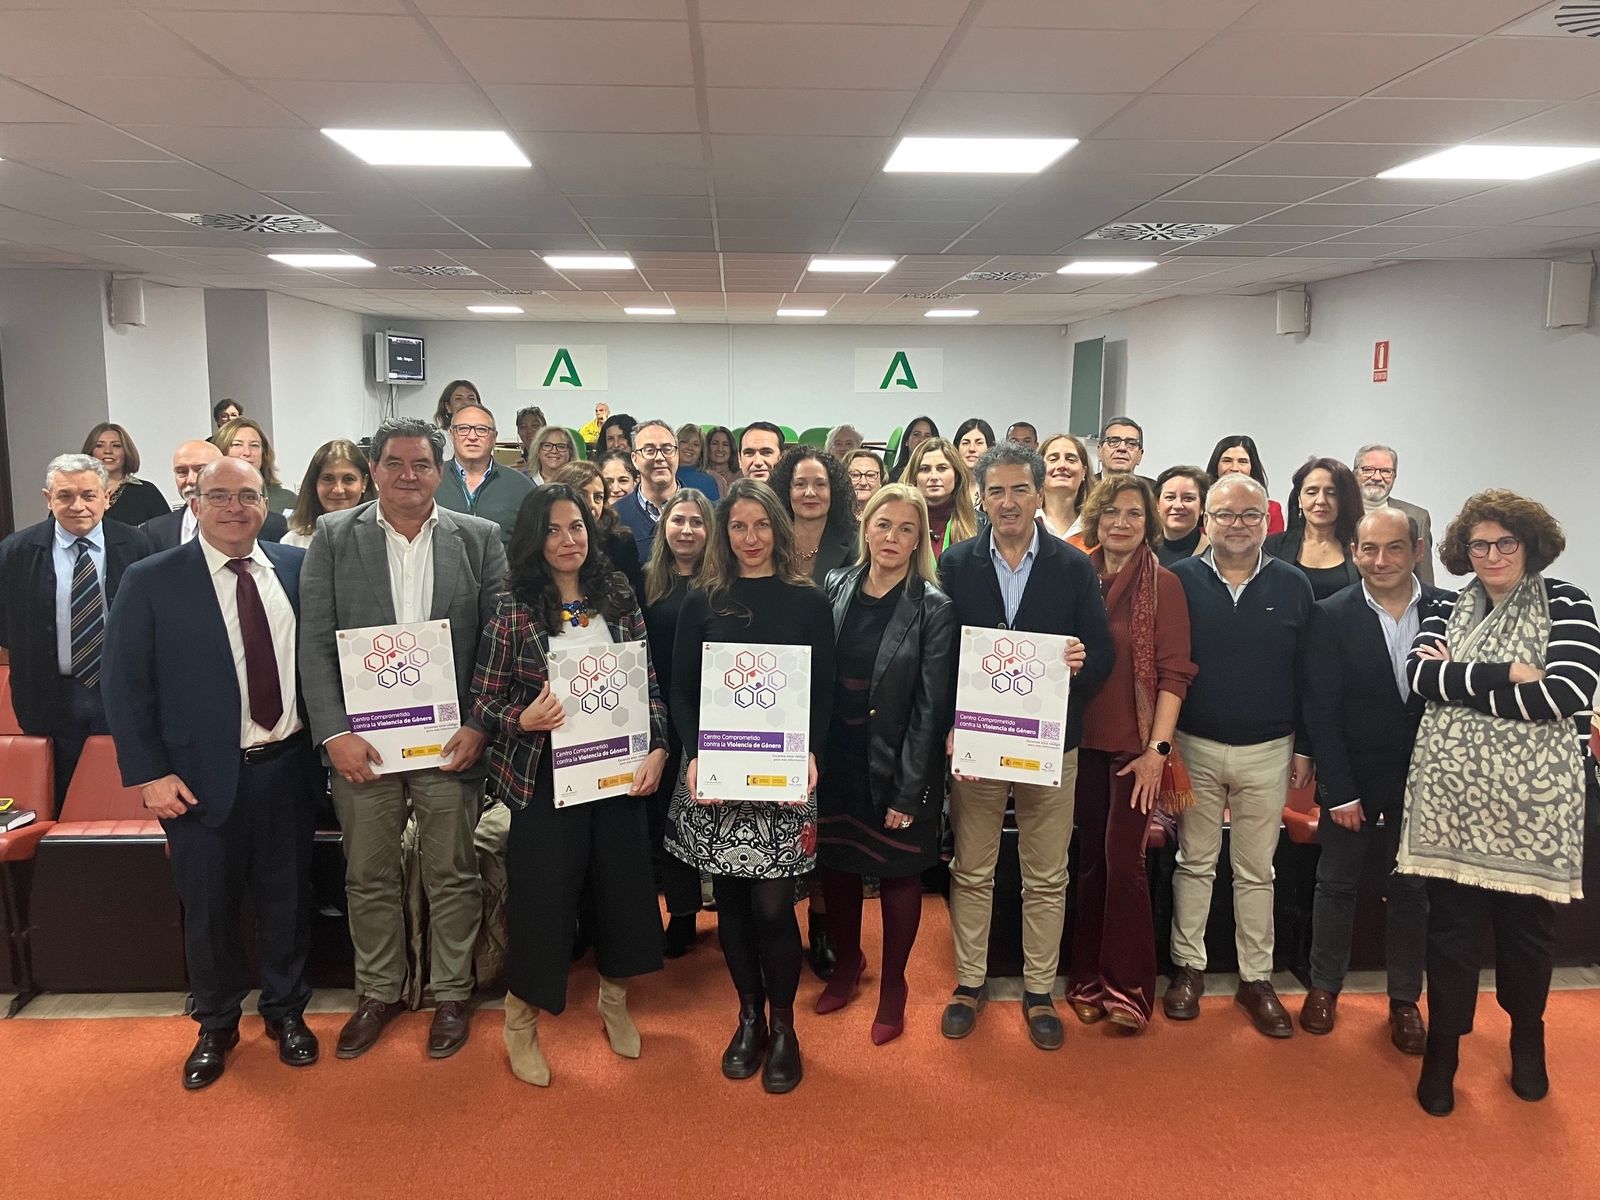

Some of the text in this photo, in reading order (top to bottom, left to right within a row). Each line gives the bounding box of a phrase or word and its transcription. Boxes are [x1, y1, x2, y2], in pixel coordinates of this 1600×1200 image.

[371, 711, 410, 721] Comprometido
[978, 716, 1016, 726] Comprometido
[982, 724, 1007, 732] Violencia
[1016, 727, 1036, 735] Género
[722, 734, 760, 742] Comprometido
[573, 744, 608, 754] Comprometido
[578, 752, 602, 761] Violencia
